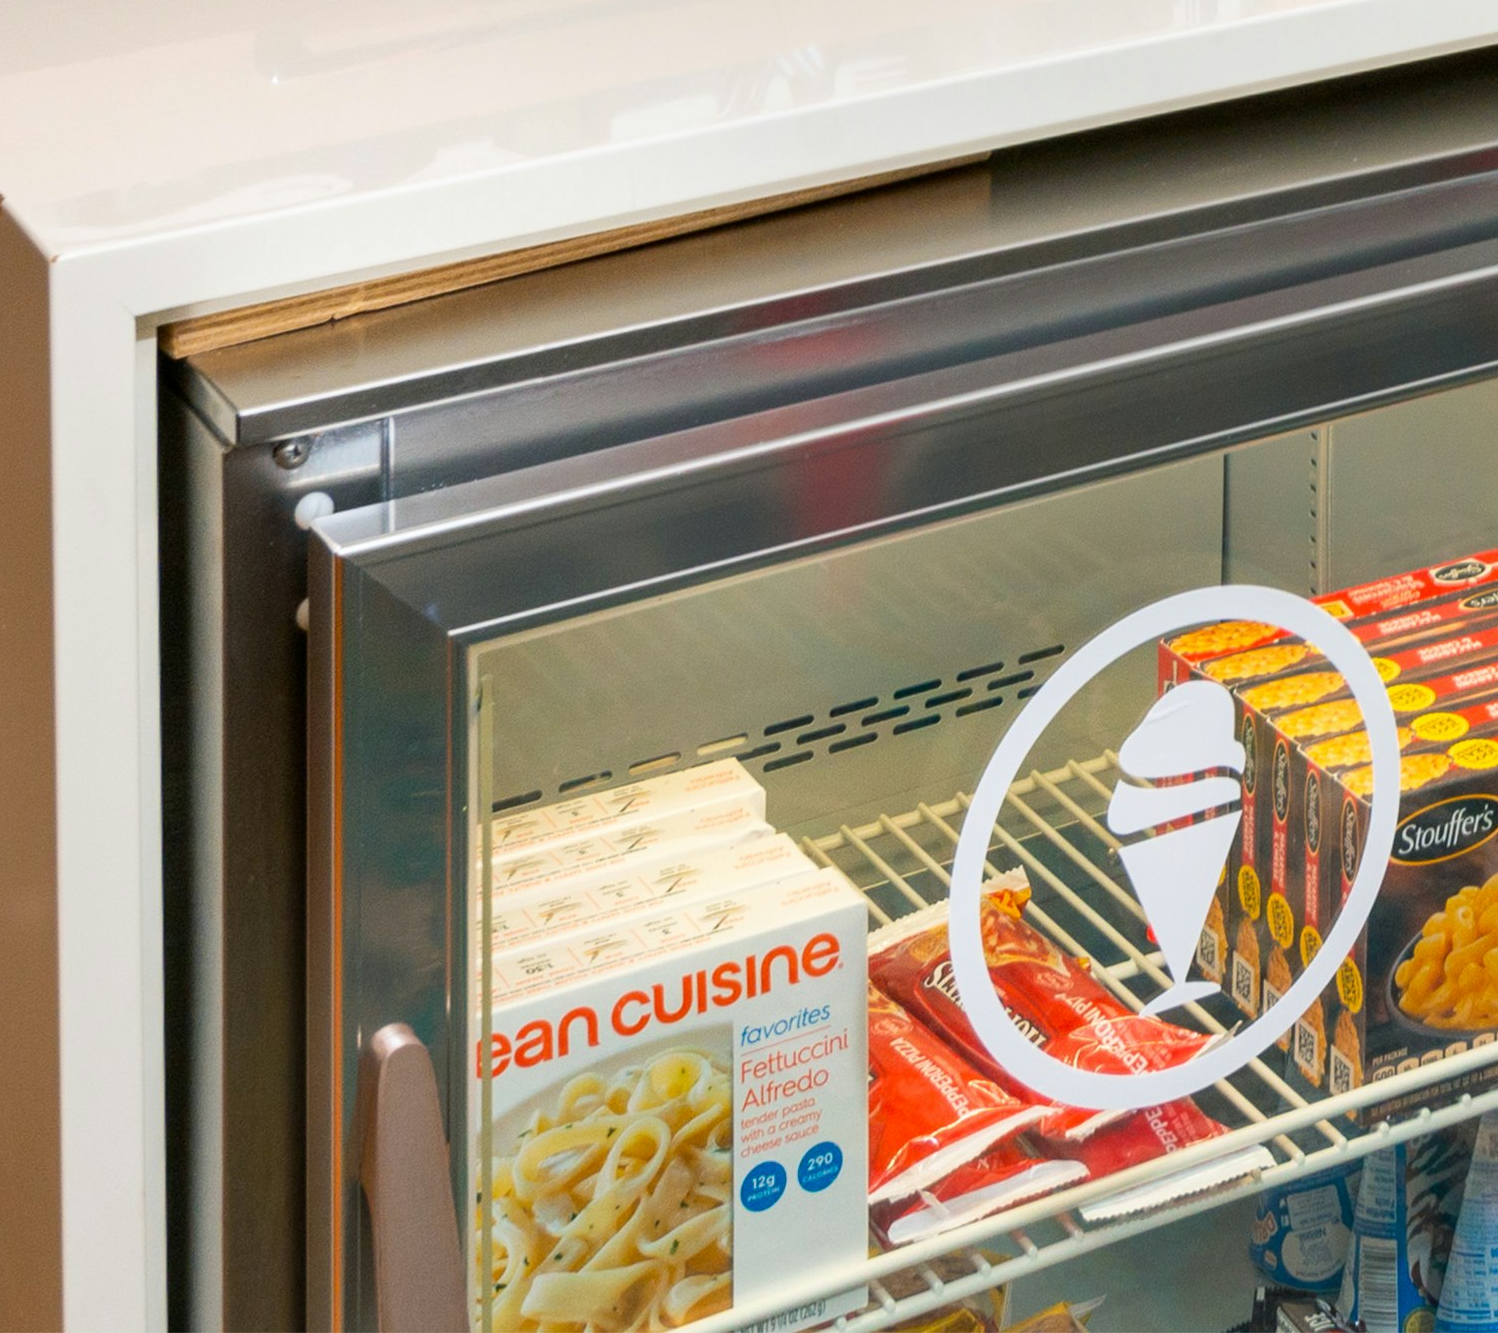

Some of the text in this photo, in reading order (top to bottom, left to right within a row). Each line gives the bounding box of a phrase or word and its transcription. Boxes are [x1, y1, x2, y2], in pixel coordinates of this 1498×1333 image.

[1397, 804, 1494, 855] Stouffer's
[610, 931, 842, 1038] cuisine
[740, 1003, 831, 1048] favorites
[740, 1028, 850, 1084] Fettuccini
[888, 1035, 927, 1074] PIZZA
[740, 1067, 830, 1113] Alfredo
[919, 1067, 972, 1119] PEPPERONI
[740, 1097, 817, 1131] tender pasta
[740, 1109, 823, 1145] with a creamy
[740, 1124, 820, 1159] cheese sauce
[806, 1152, 834, 1170] 290
[750, 1174, 776, 1191] 12g
